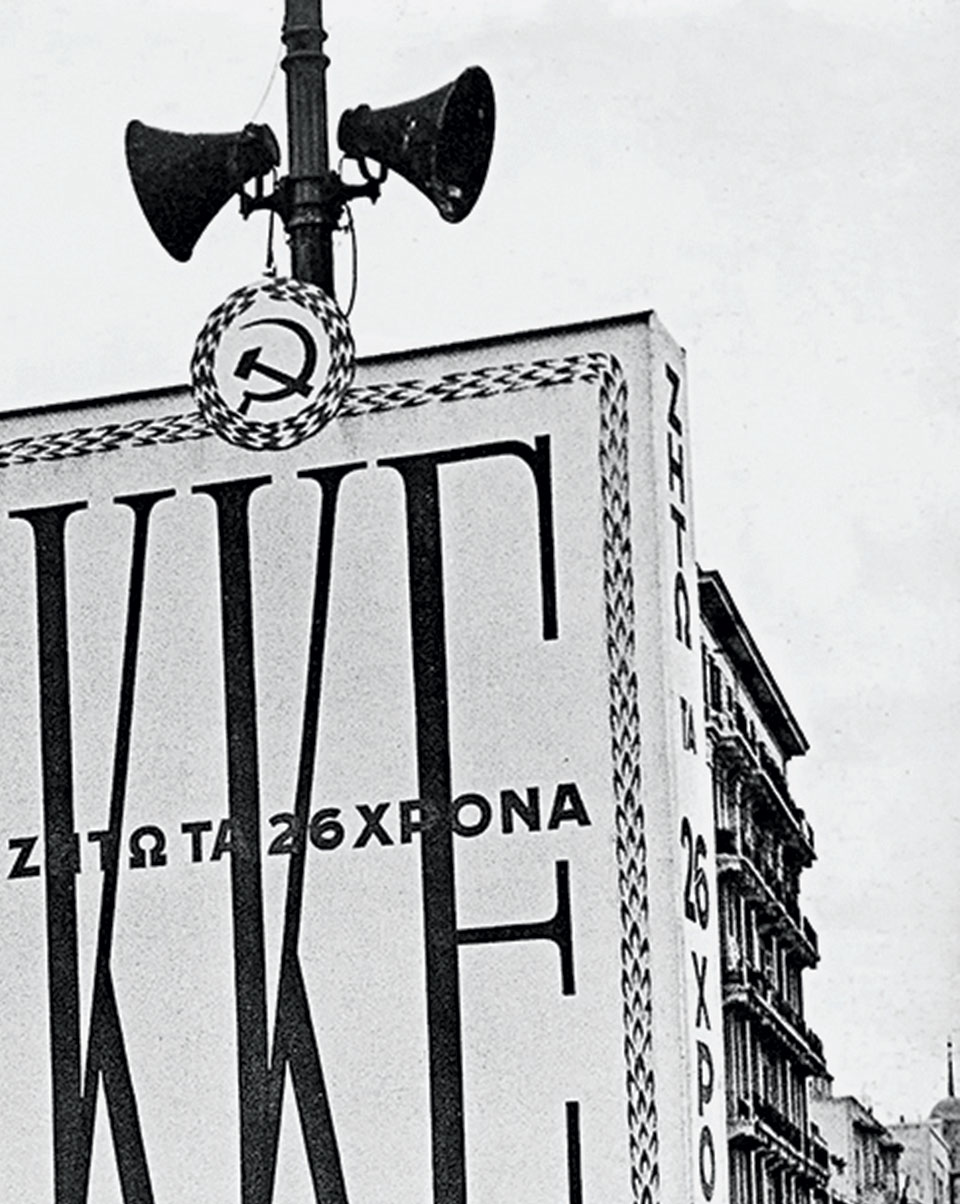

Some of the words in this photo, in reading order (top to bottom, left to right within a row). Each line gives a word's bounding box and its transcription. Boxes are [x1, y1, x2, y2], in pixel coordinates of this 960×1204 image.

[665, 362, 692, 650] ΖΗΤΩ
[679, 696, 698, 754] ΤΑ
[267, 807, 345, 856] 26
[352, 782, 592, 849] ΧΡΟΝΑ
[681, 816, 709, 930] 26
